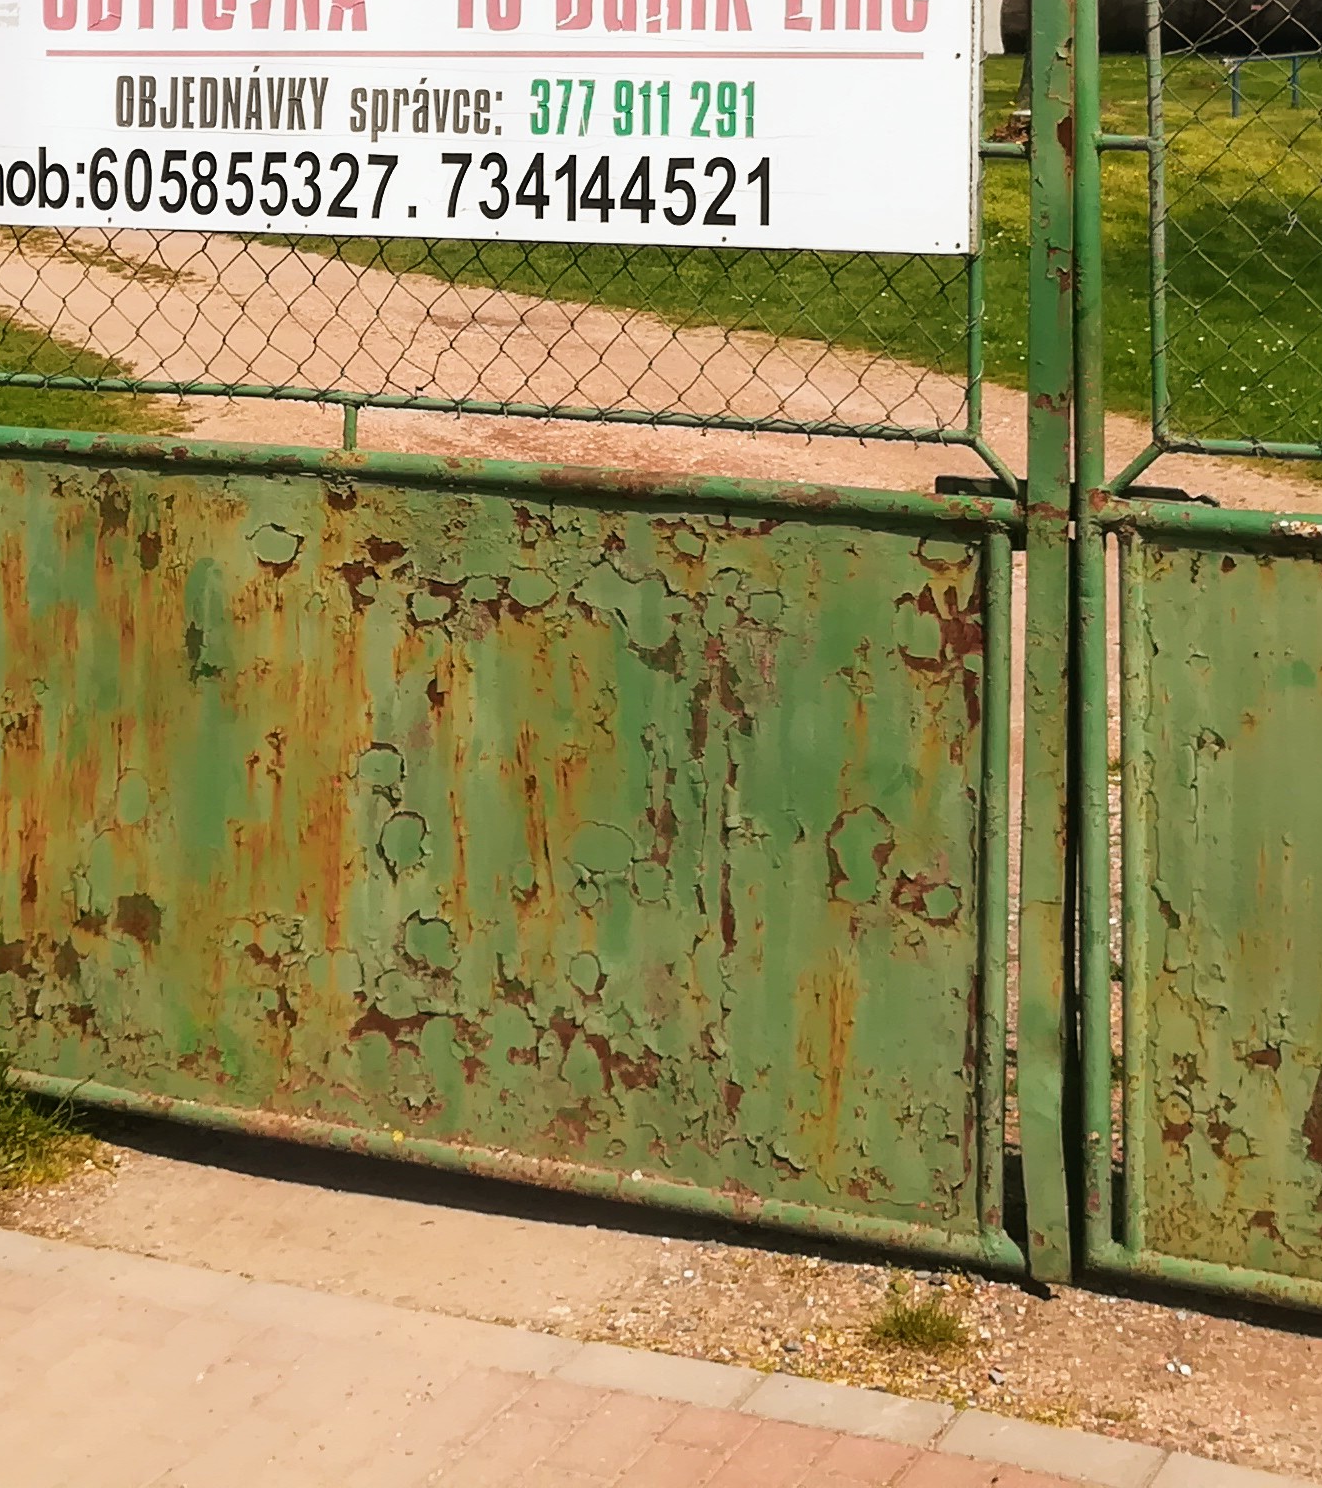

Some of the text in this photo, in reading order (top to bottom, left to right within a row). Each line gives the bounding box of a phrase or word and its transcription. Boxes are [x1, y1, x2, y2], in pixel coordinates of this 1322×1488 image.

[116, 65, 756, 143] OBJEDNÁVKY správce: 377 911 291
[441, 152, 771, 228] 734144521
